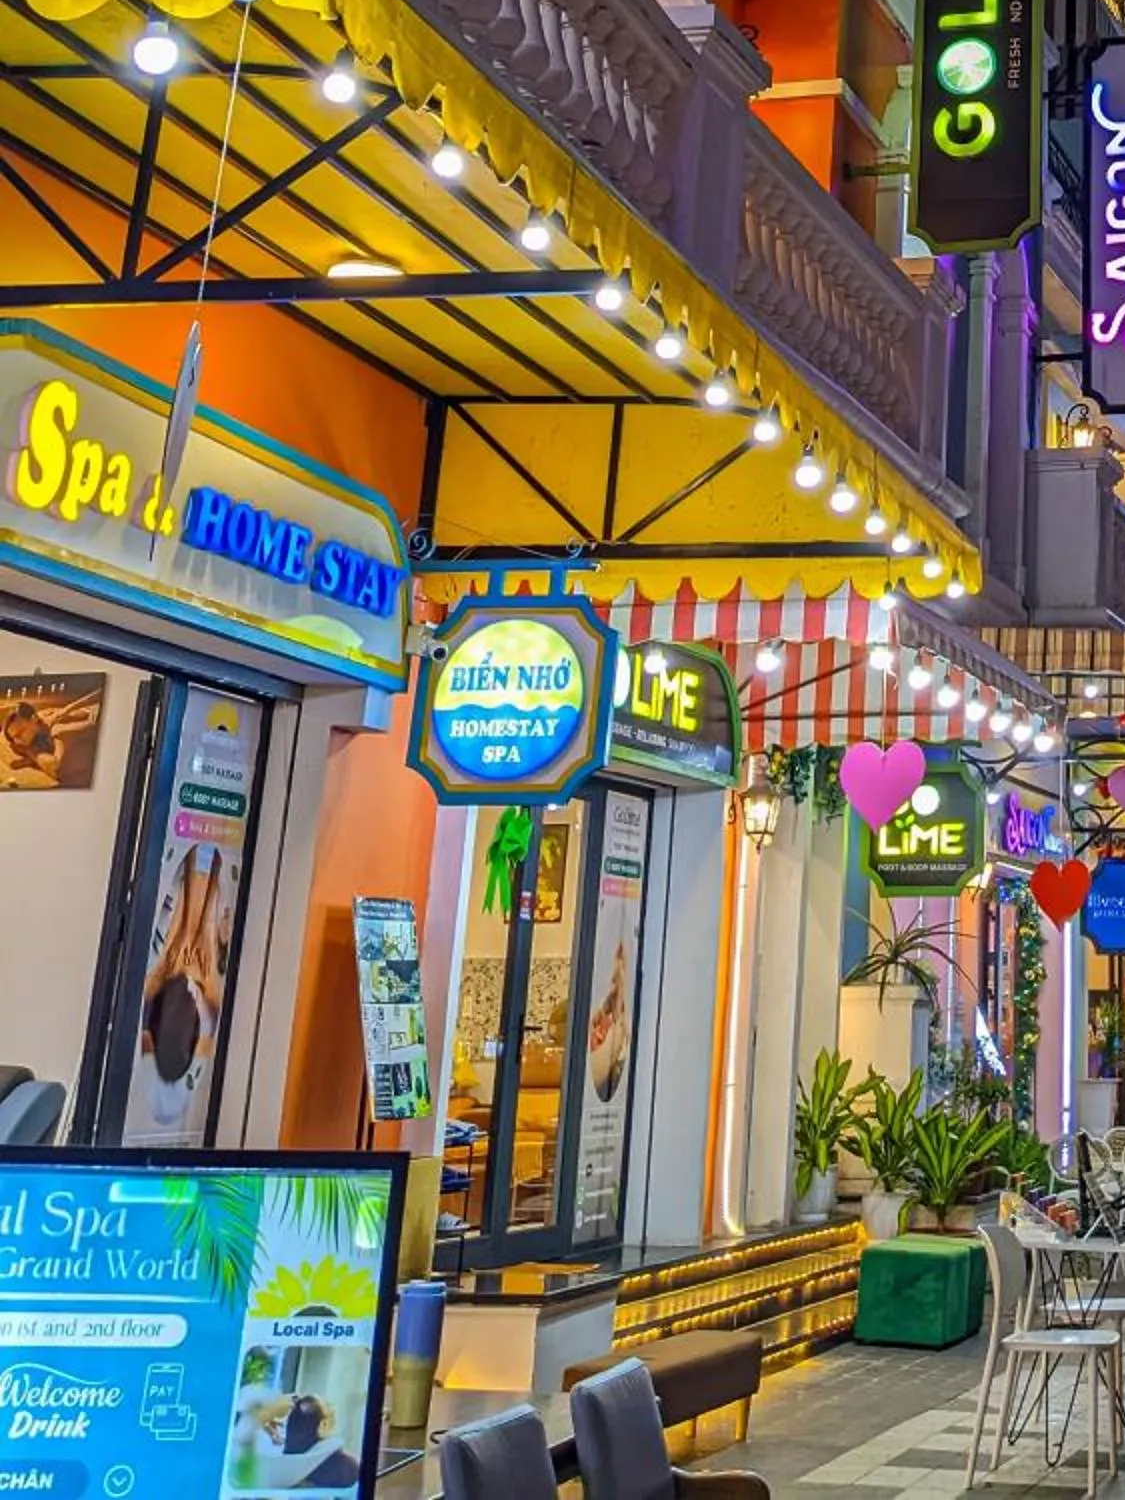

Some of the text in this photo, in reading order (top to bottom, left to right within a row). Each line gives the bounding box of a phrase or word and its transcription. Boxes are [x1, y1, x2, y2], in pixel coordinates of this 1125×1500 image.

[1007, 37, 1021, 89] FRESH
[12, 380, 132, 522] Spa
[184, 486, 314, 585] HOME
[312, 538, 407, 619] STAY
[450, 718, 560, 738] HOMESTAY
[481, 745, 521, 764] SPA
[41, 1191, 128, 1252] Spa
[105, 1247, 201, 1281] World
[43, 1317, 78, 1338] and
[83, 1318, 116, 1338] 2nd
[120, 1318, 164, 1338] floor
[272, 1321, 354, 1340] Local Spa
[0, 1366, 123, 1409] Welcome
[150, 1385, 174, 1397] PAY
[8, 1411, 92, 1440] Drink
